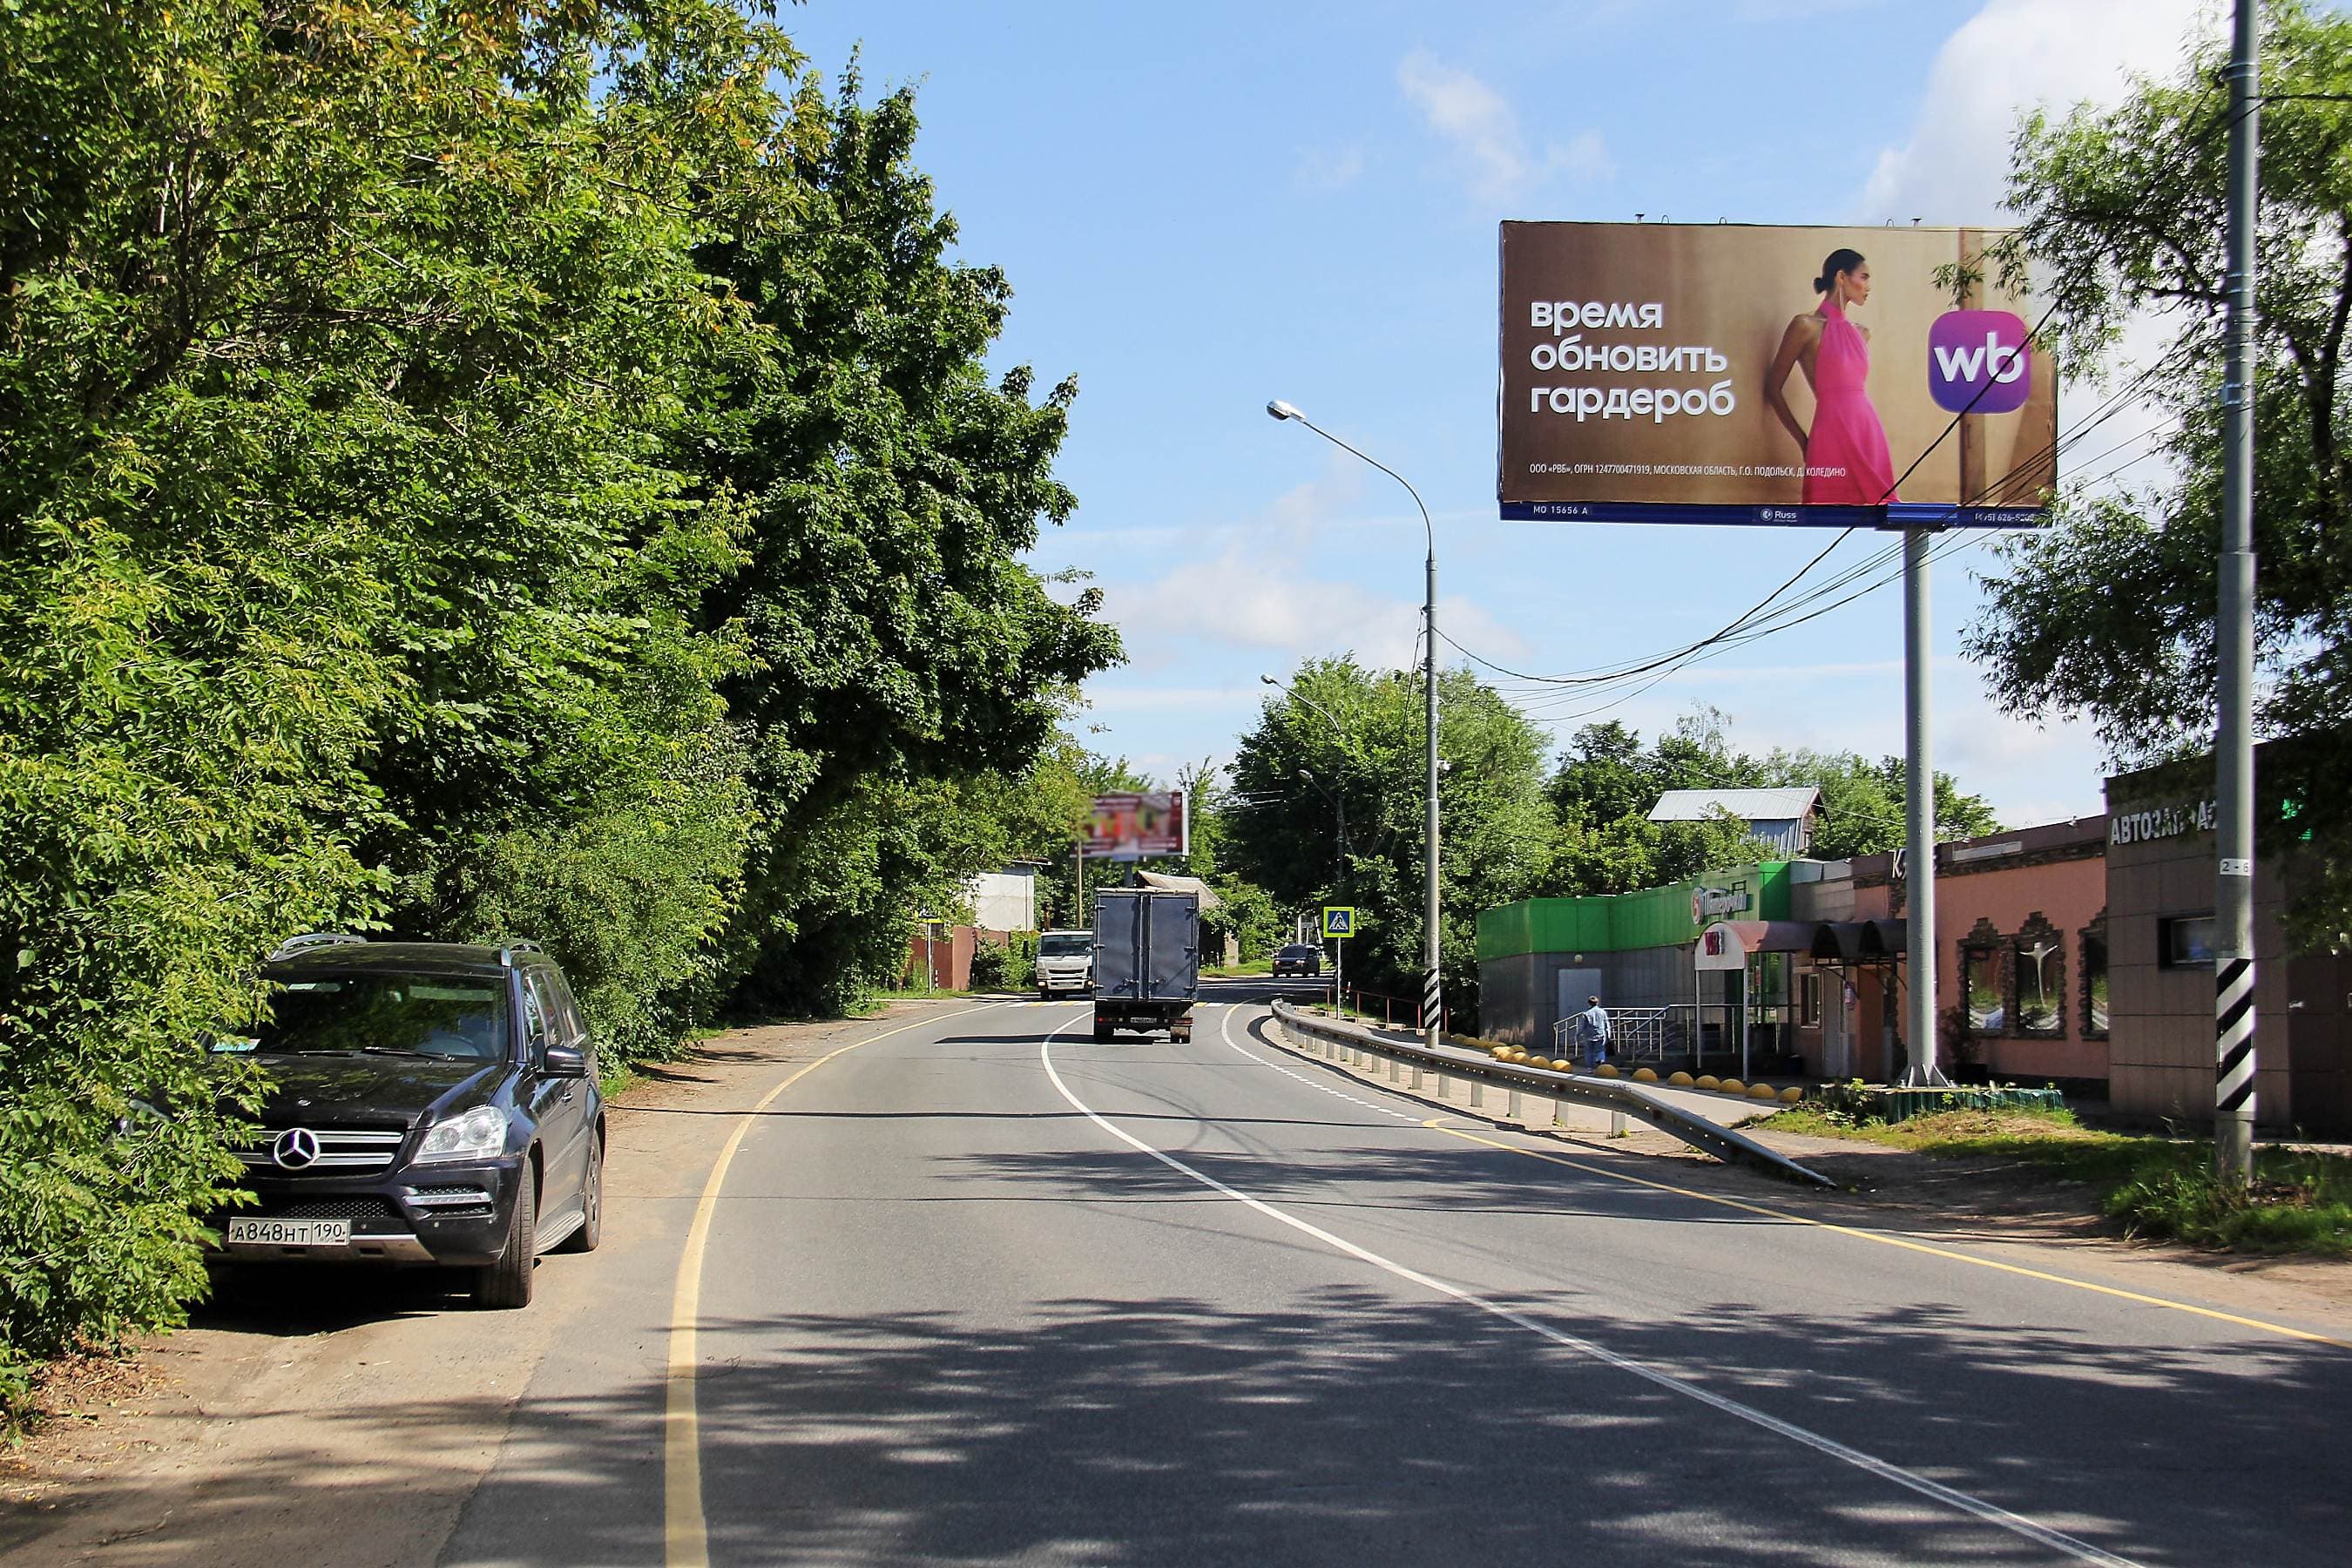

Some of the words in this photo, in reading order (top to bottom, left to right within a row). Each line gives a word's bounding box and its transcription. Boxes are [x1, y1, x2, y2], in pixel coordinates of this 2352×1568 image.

[1531, 301, 1663, 336] время
[1531, 335, 1727, 372] обновить
[1933, 331, 2024, 384] wb
[1531, 380, 1734, 423] гардероб
[1530, 463, 1547, 473] ООО
[1548, 463, 1572, 474] «РВБ»,
[1574, 463, 1593, 474] ОГРН
[1596, 464, 1652, 475] 1247700471919,
[1654, 465, 1702, 475] МОСКОВСКАЯ
[1704, 465, 1738, 476] ОБЛАСТЬ,
[1739, 467, 1753, 476] Г.О.
[1754, 467, 1795, 477] ПОДОЛЬСК,
[1806, 467, 1846, 477] КОЛЕДИНО
[1551, 506, 1578, 515] 15656
[1774, 510, 1796, 519] Russ
[234, 1222, 308, 1241] А848НТ
[314, 1224, 342, 1238] 190
